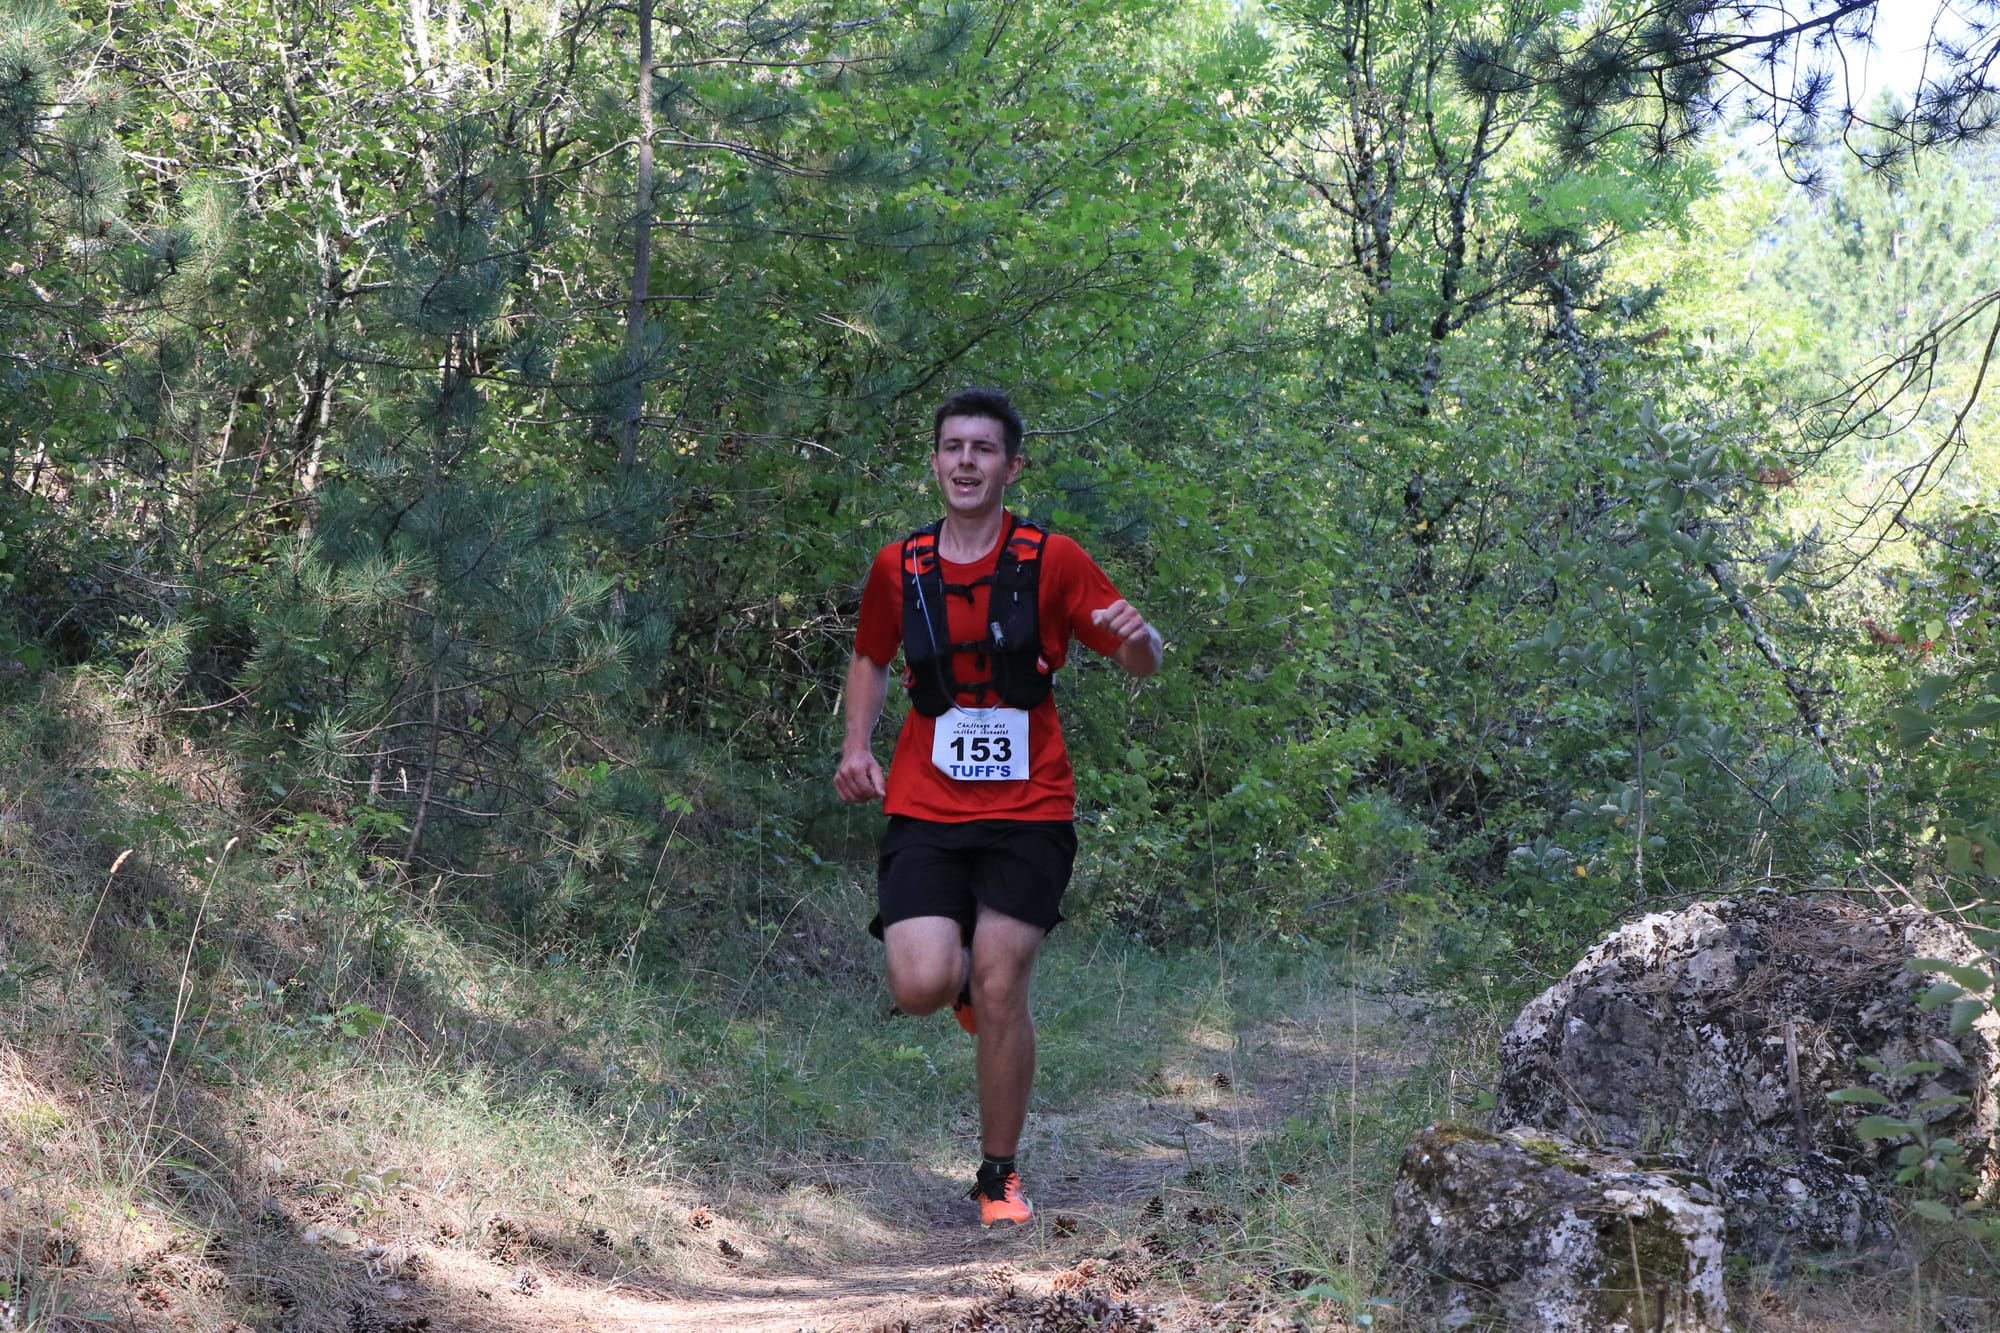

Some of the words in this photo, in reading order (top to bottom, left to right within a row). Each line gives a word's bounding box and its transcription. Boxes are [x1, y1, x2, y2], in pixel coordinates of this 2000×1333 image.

[956, 722, 990, 731] Challenge
[950, 737, 1012, 762] 153
[949, 765, 1011, 777] TUFF'S
